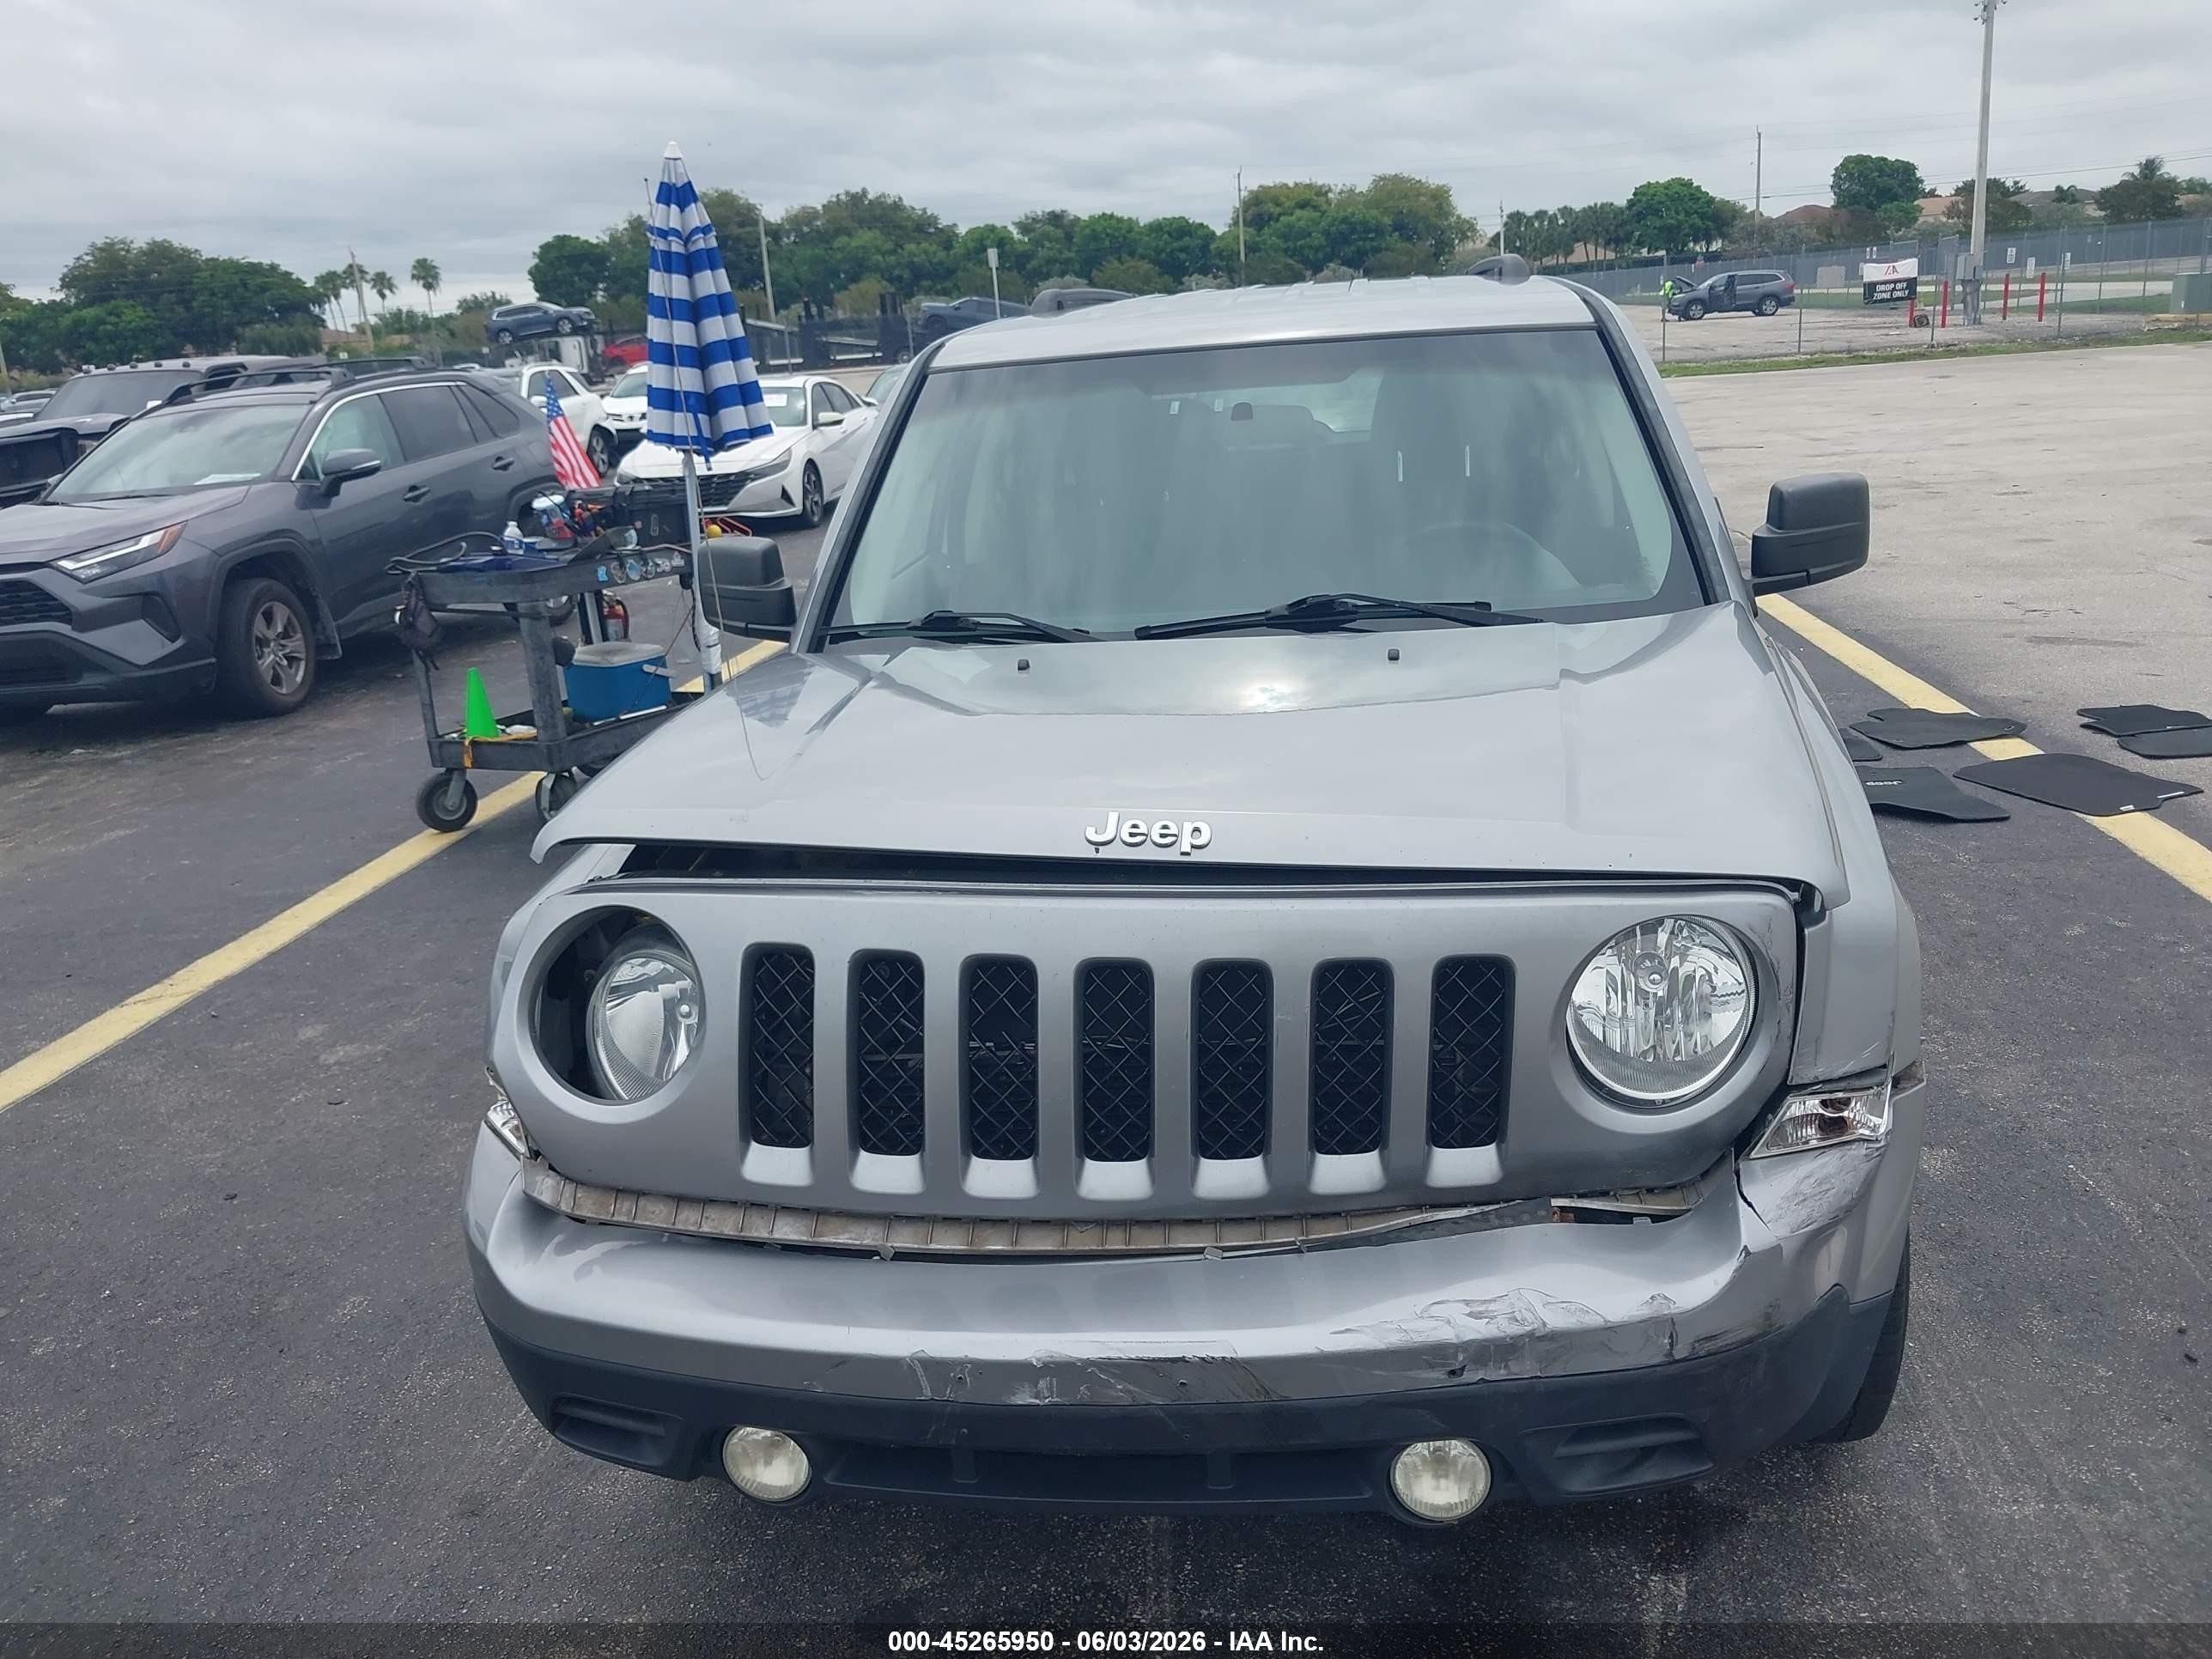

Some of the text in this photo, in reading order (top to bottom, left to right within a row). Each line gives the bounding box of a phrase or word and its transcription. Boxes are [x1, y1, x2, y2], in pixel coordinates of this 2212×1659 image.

[1876, 283, 1894, 292] DROP
[1873, 289, 1909, 300] ZONE ONLY
[1085, 811, 1212, 856] Jeep
